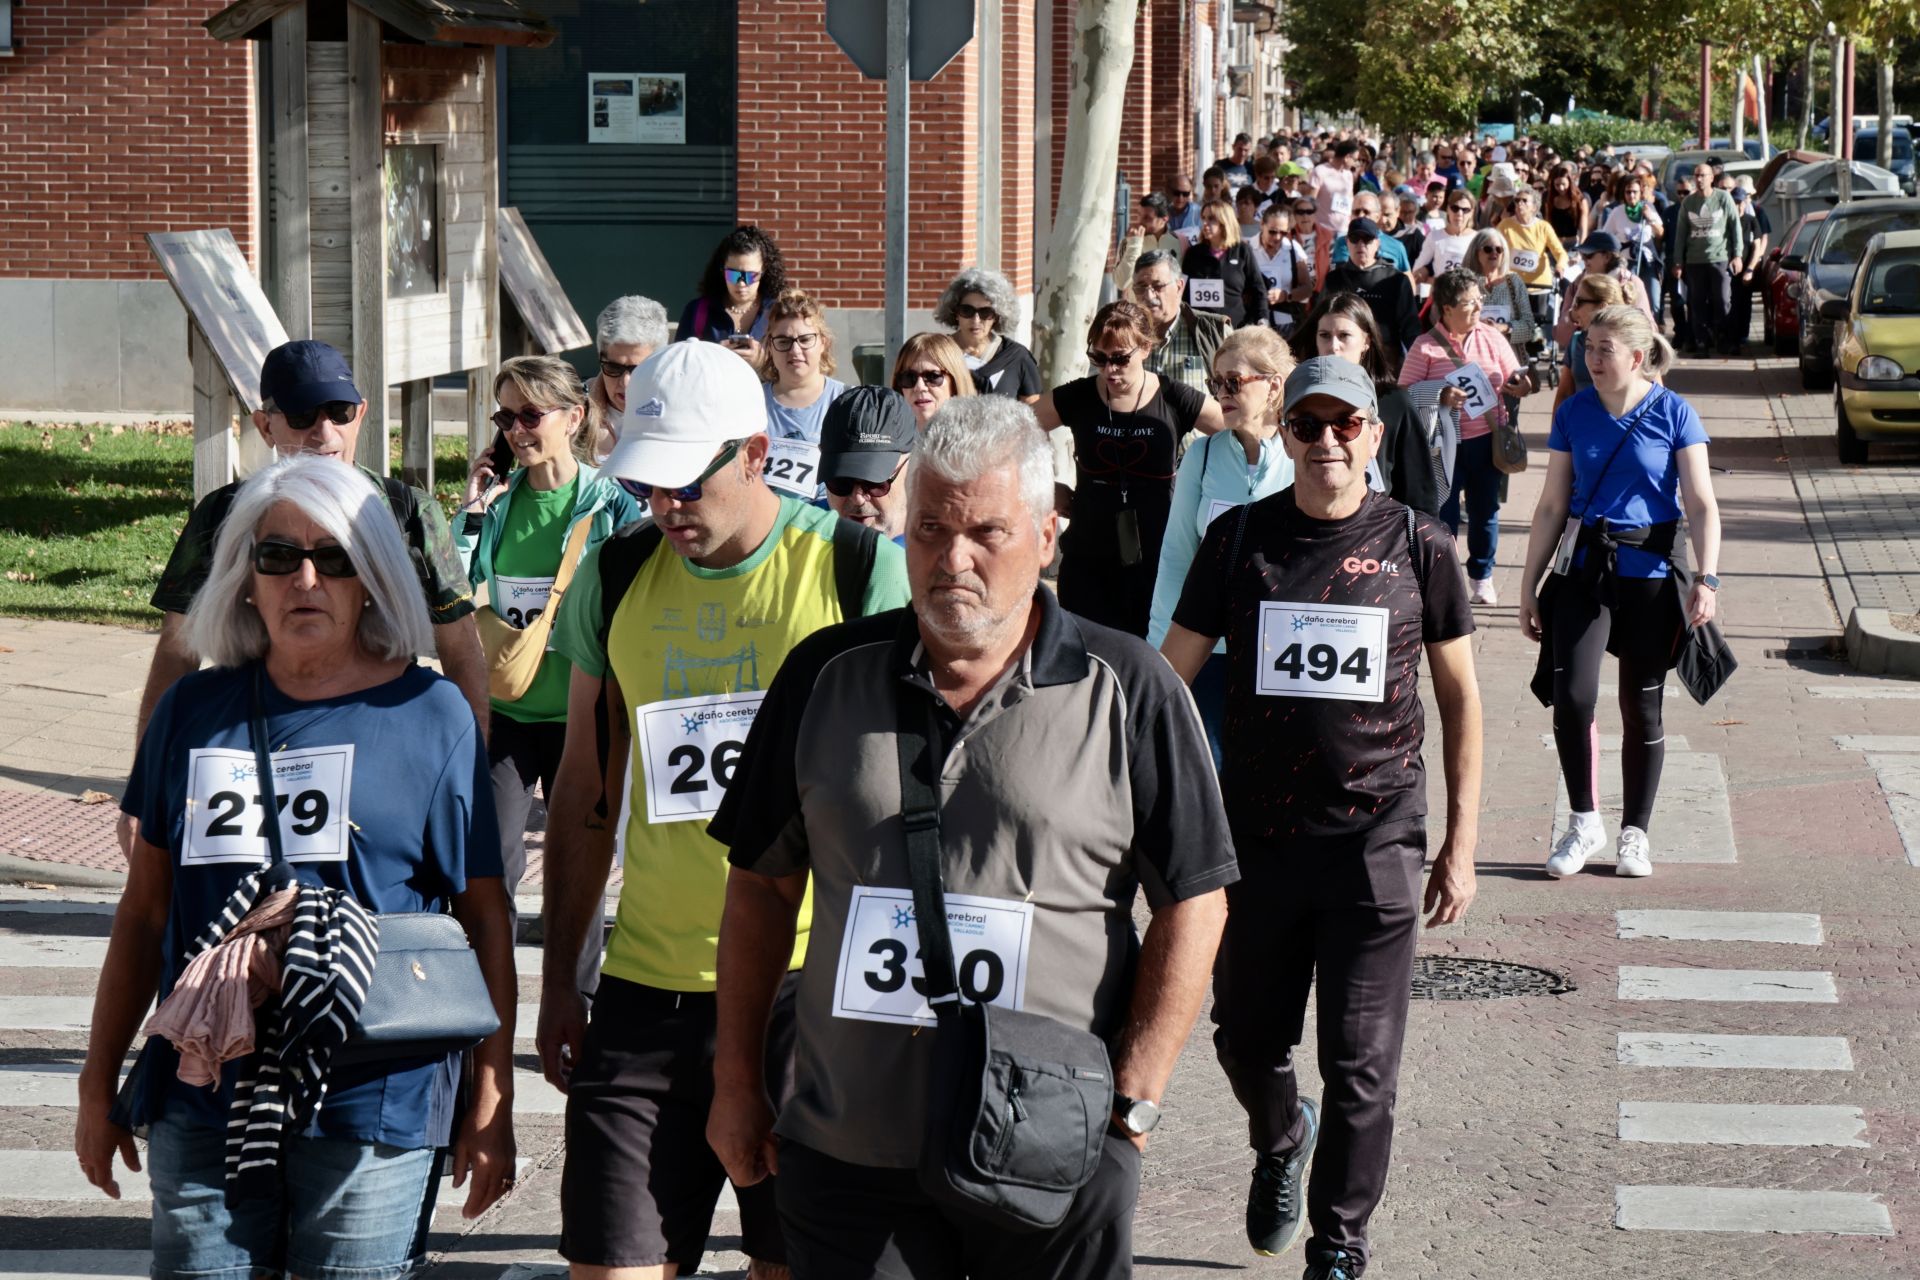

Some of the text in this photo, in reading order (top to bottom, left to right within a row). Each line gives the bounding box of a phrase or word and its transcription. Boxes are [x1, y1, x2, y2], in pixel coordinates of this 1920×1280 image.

[1513, 256, 1535, 269] 029
[1194, 290, 1221, 302] 396
[1457, 376, 1485, 408] 407
[763, 456, 814, 484] 427
[1304, 615, 1358, 625] daño cerebral
[1274, 643, 1371, 684] 494
[698, 710, 723, 720] daño
[726, 707, 759, 718] cerebr
[276, 761, 314, 773] cerebral
[947, 912, 987, 923] erebral
